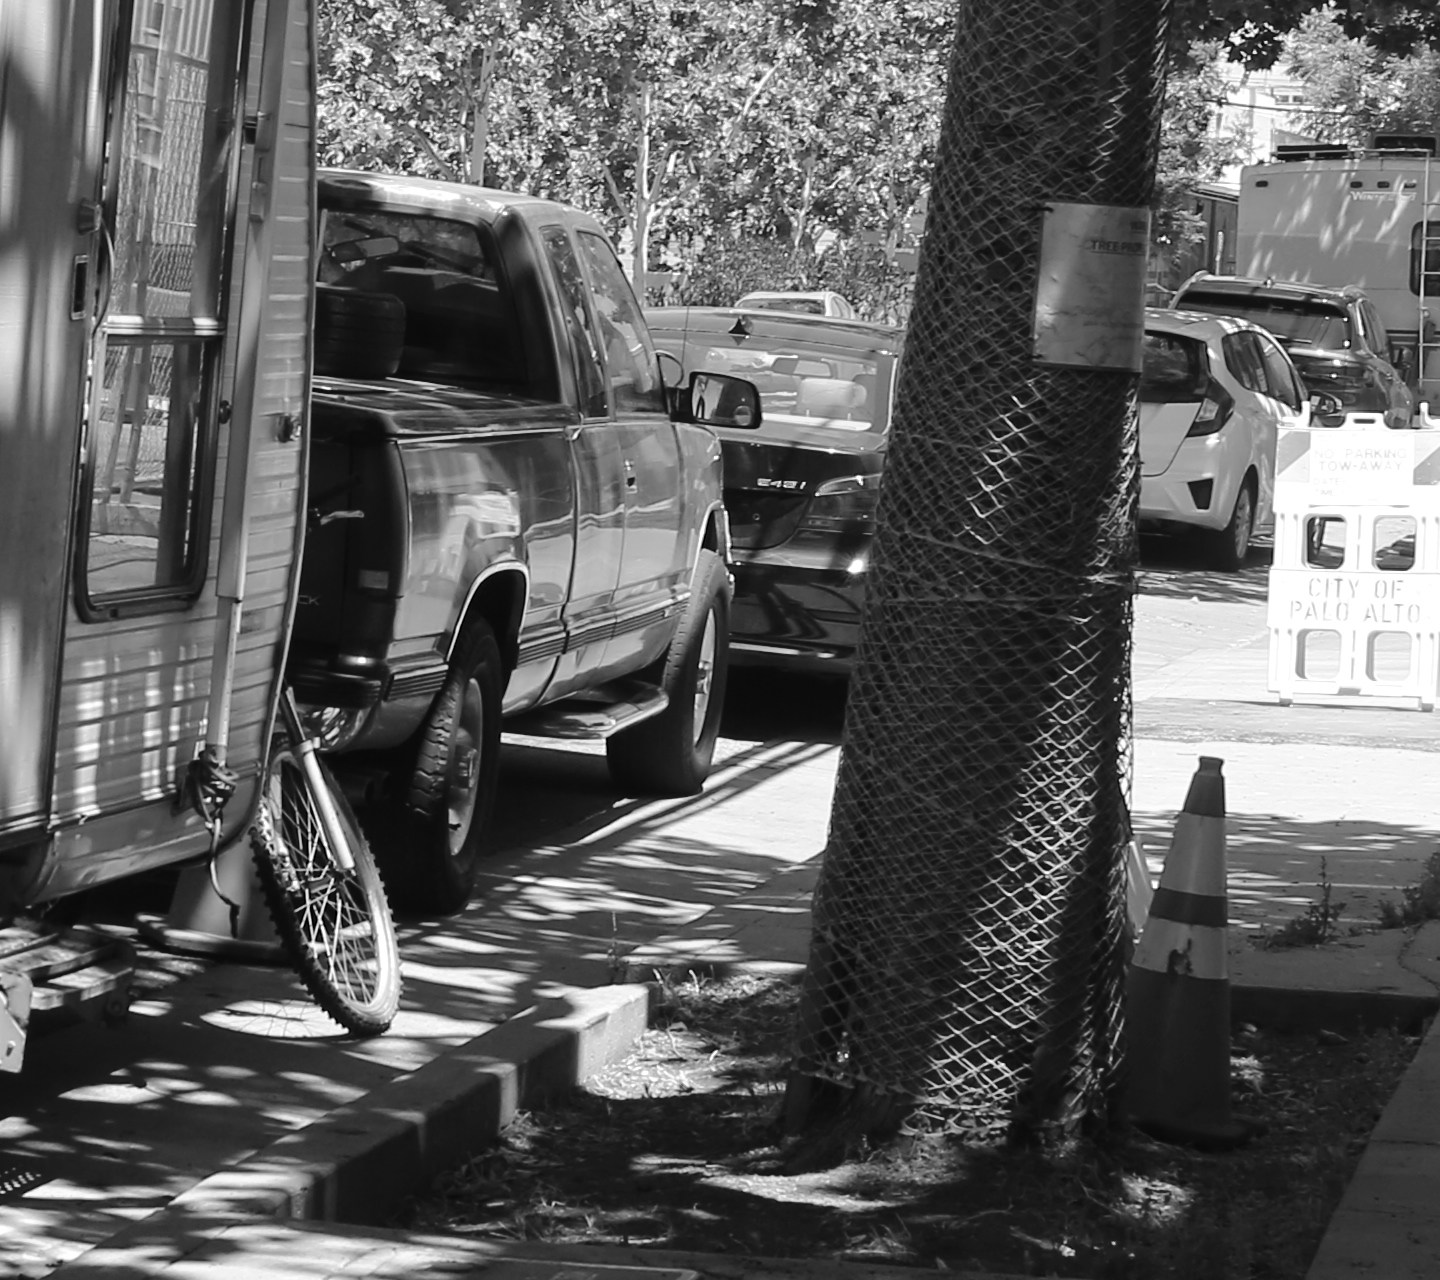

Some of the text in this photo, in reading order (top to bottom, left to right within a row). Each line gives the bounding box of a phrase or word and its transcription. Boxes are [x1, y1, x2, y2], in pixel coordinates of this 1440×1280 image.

[1314, 448, 1408, 460] NO PARKING
[1320, 460, 1403, 472] TOW-AWAY
[1308, 578, 1404, 599] CITY OF
[1290, 600, 1420, 623] PALO ALTO
